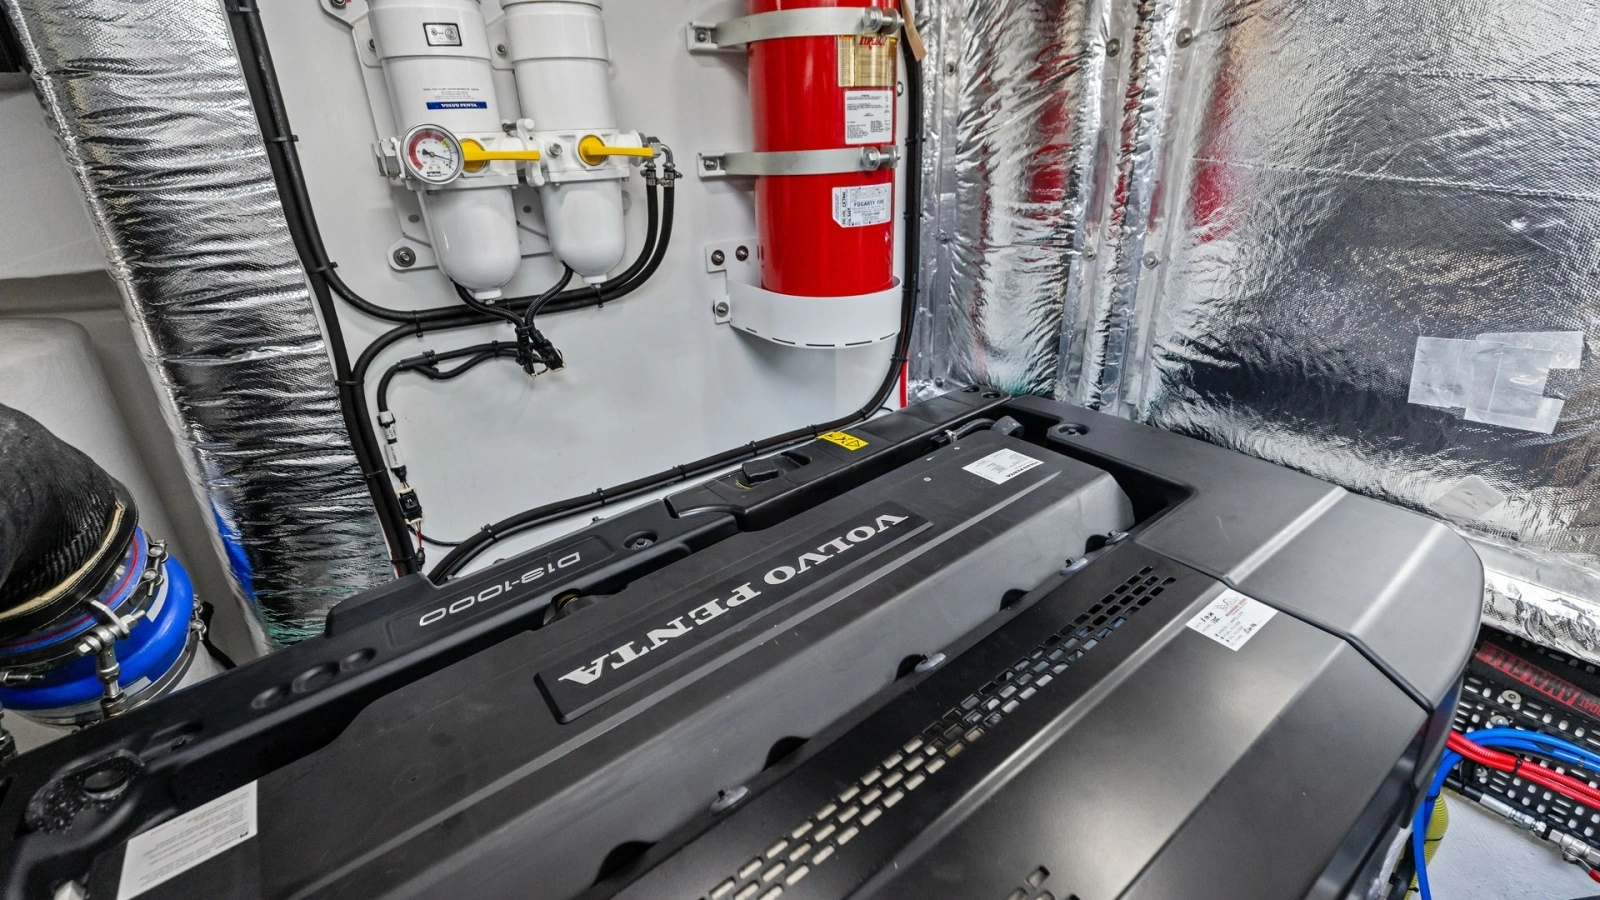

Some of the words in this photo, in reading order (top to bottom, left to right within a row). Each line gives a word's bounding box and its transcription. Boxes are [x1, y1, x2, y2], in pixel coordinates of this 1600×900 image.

[764, 514, 909, 585] VOLVO
[419, 552, 580, 626] D13-1000
[558, 582, 761, 684] PENTA
